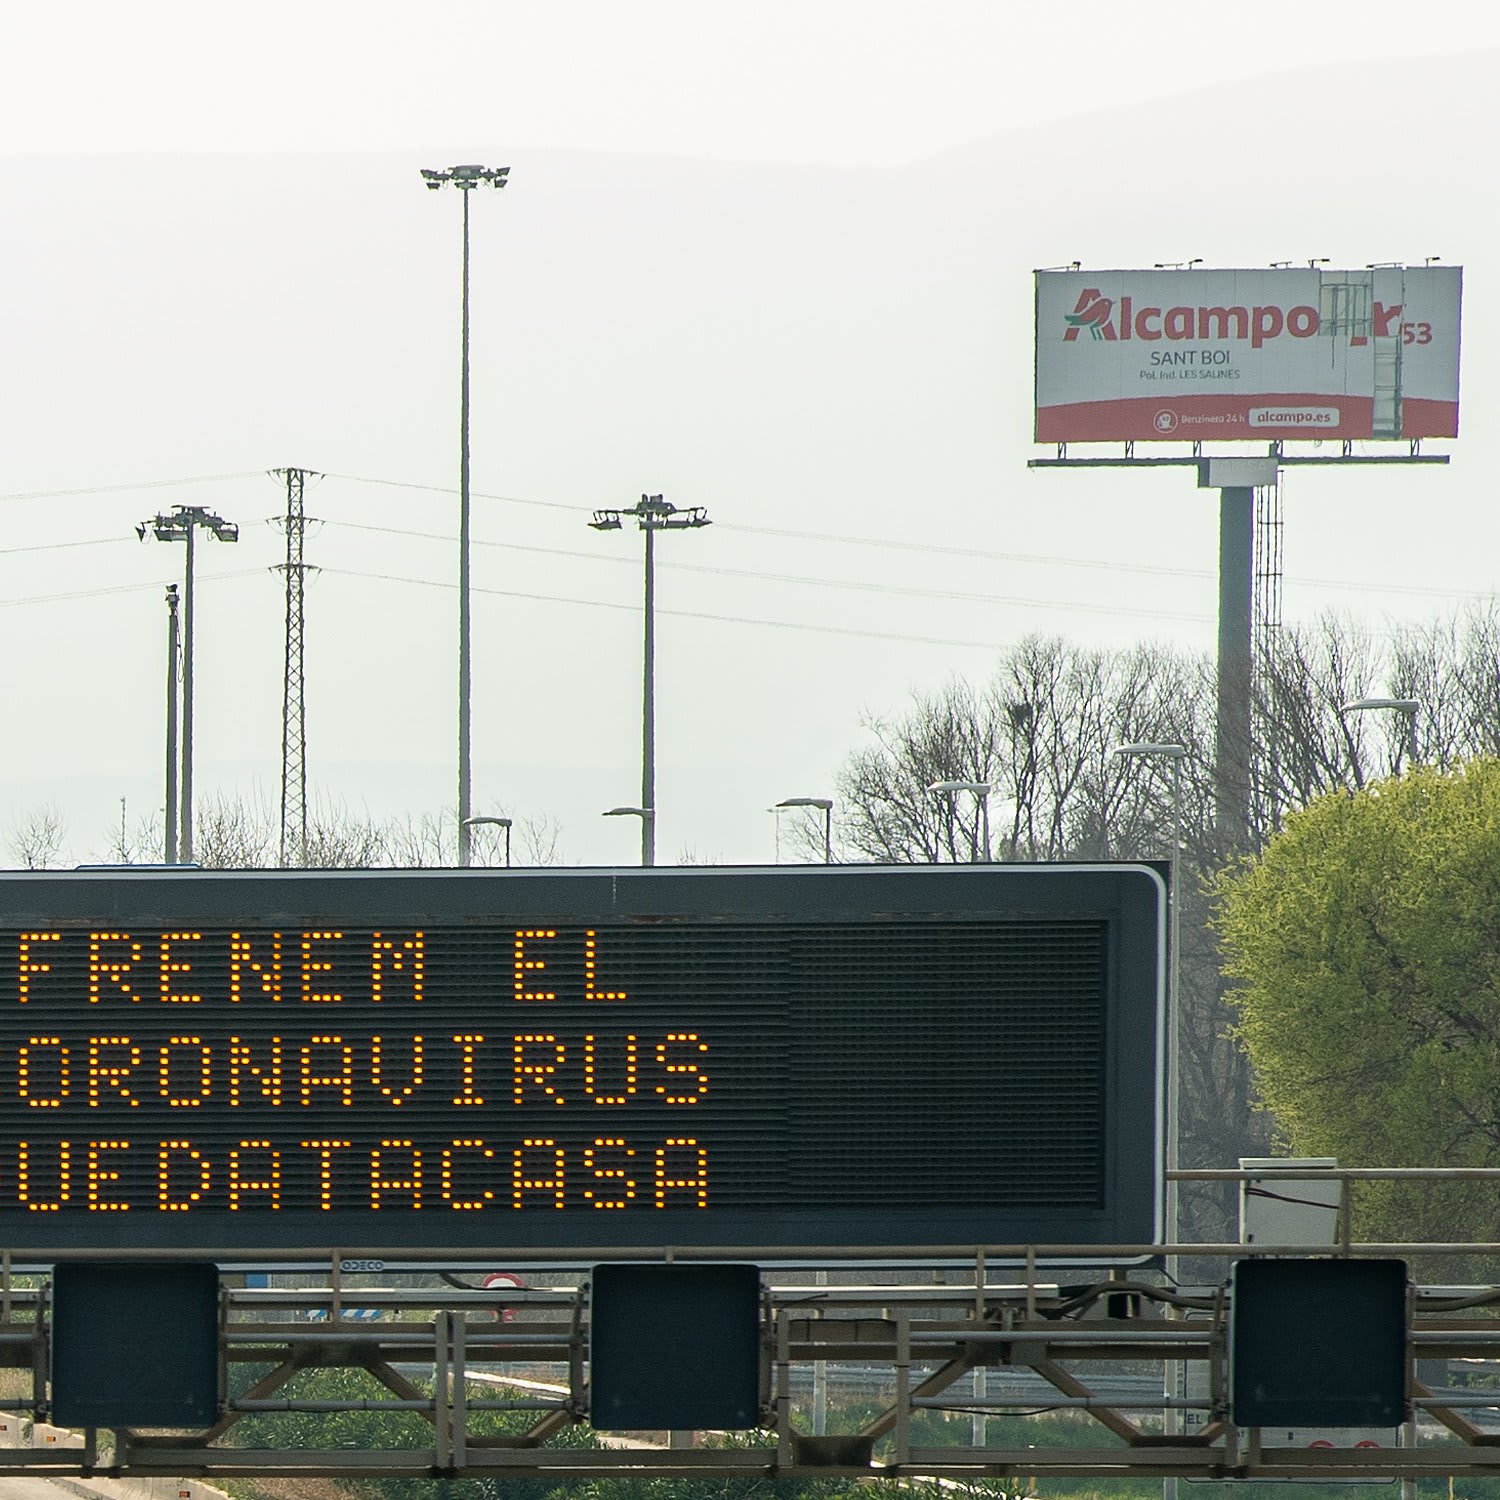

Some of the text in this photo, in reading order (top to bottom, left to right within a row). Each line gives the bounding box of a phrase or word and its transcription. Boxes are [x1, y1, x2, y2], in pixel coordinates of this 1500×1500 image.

[1063, 288, 1321, 349] Alcampo
[1402, 322, 1433, 345] 53
[1150, 350, 1231, 366] SANT BOI
[1179, 369, 1198, 379] LES
[1199, 369, 1241, 380] SALINES
[1226, 413, 1238, 424] 24
[1257, 411, 1332, 425] alcampo.es
[18, 930, 628, 1004] FRENEM EL
[342, 1260, 384, 1271] ODECO
